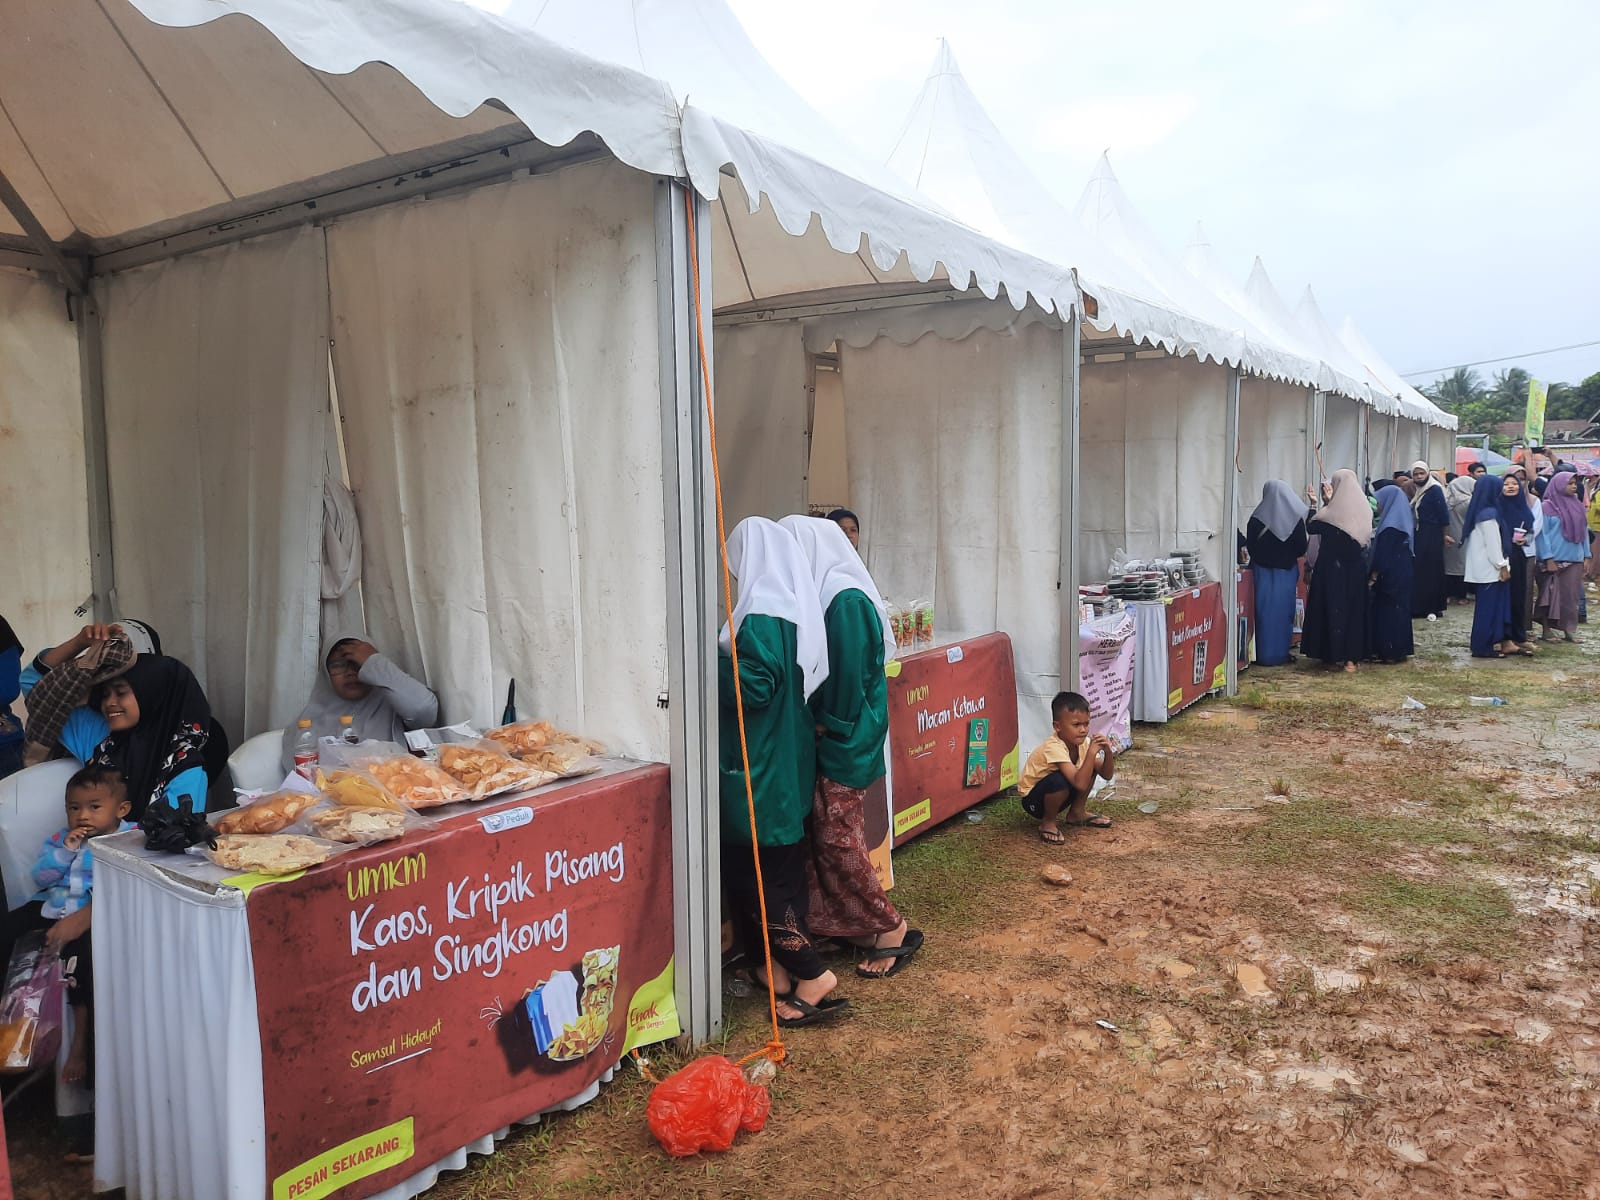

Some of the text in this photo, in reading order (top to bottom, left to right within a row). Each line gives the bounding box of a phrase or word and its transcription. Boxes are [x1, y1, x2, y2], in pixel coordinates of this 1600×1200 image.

[917, 695, 986, 734] Macan Ketawa
[347, 851, 427, 902] UMKM
[350, 841, 626, 956] Kaos, Kripik Pisang
[351, 908, 569, 1013] dan Singkong
[630, 1000, 660, 1028] Enak
[349, 1017, 443, 1069] Samsul Hidayat
[288, 1137, 400, 1200] PESAN SEKARANG
